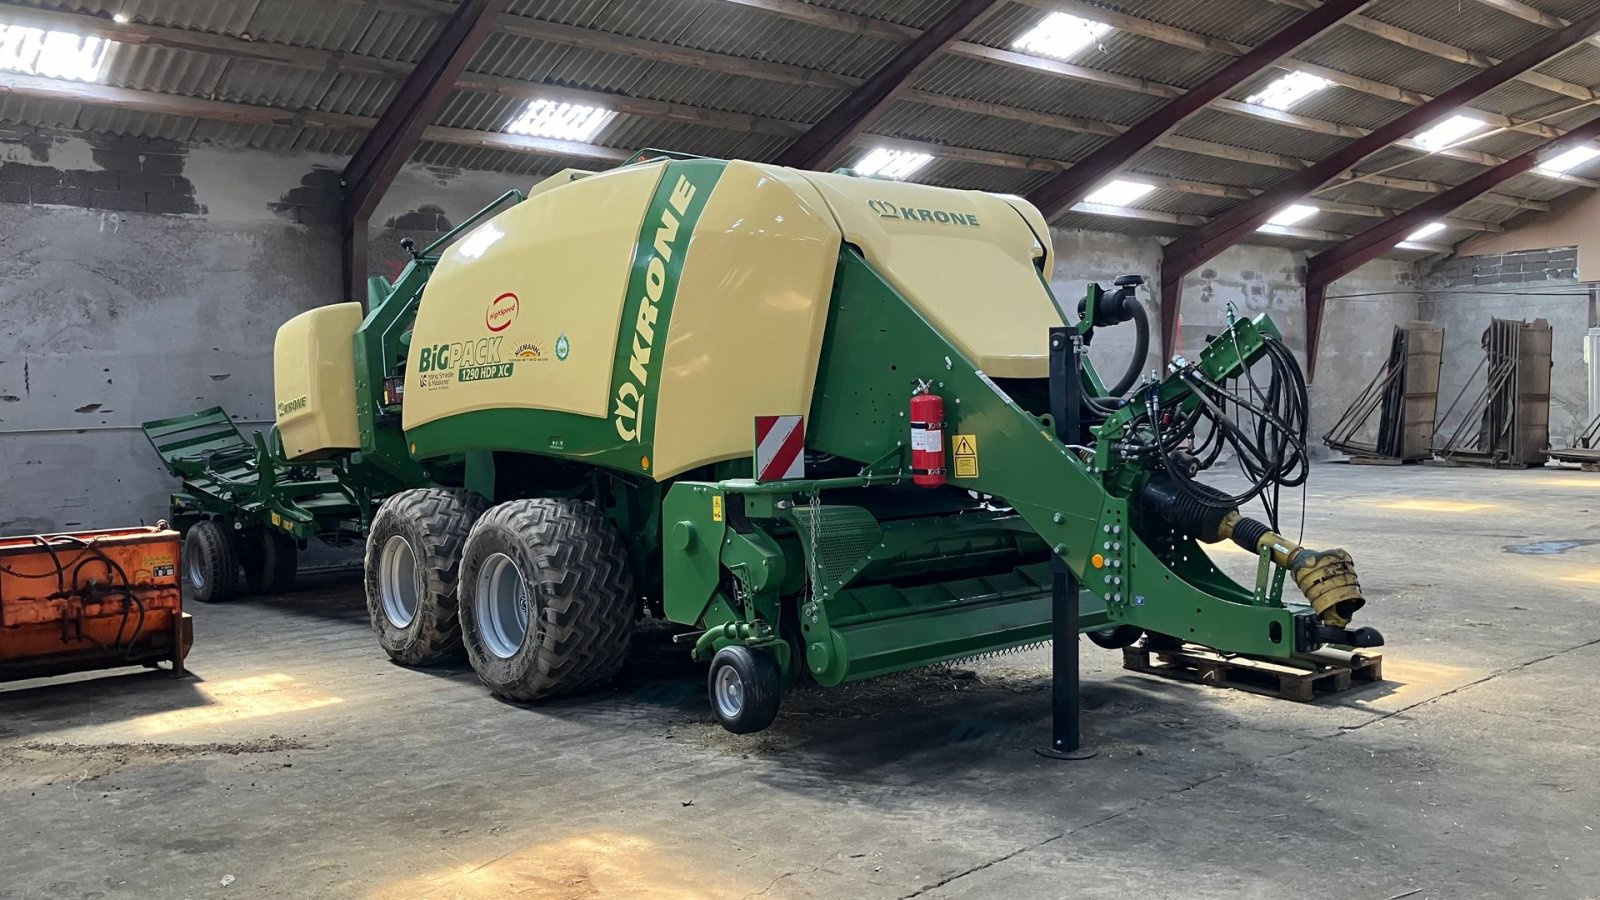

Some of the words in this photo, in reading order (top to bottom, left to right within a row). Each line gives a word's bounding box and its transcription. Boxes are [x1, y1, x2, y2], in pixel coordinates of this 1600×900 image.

[900, 207, 980, 227] KRONE
[629, 174, 697, 386] KRONE
[462, 369, 479, 381] 1290
[480, 366, 497, 379] HDP
[498, 364, 510, 377] XC
[284, 396, 307, 414] KRONE
